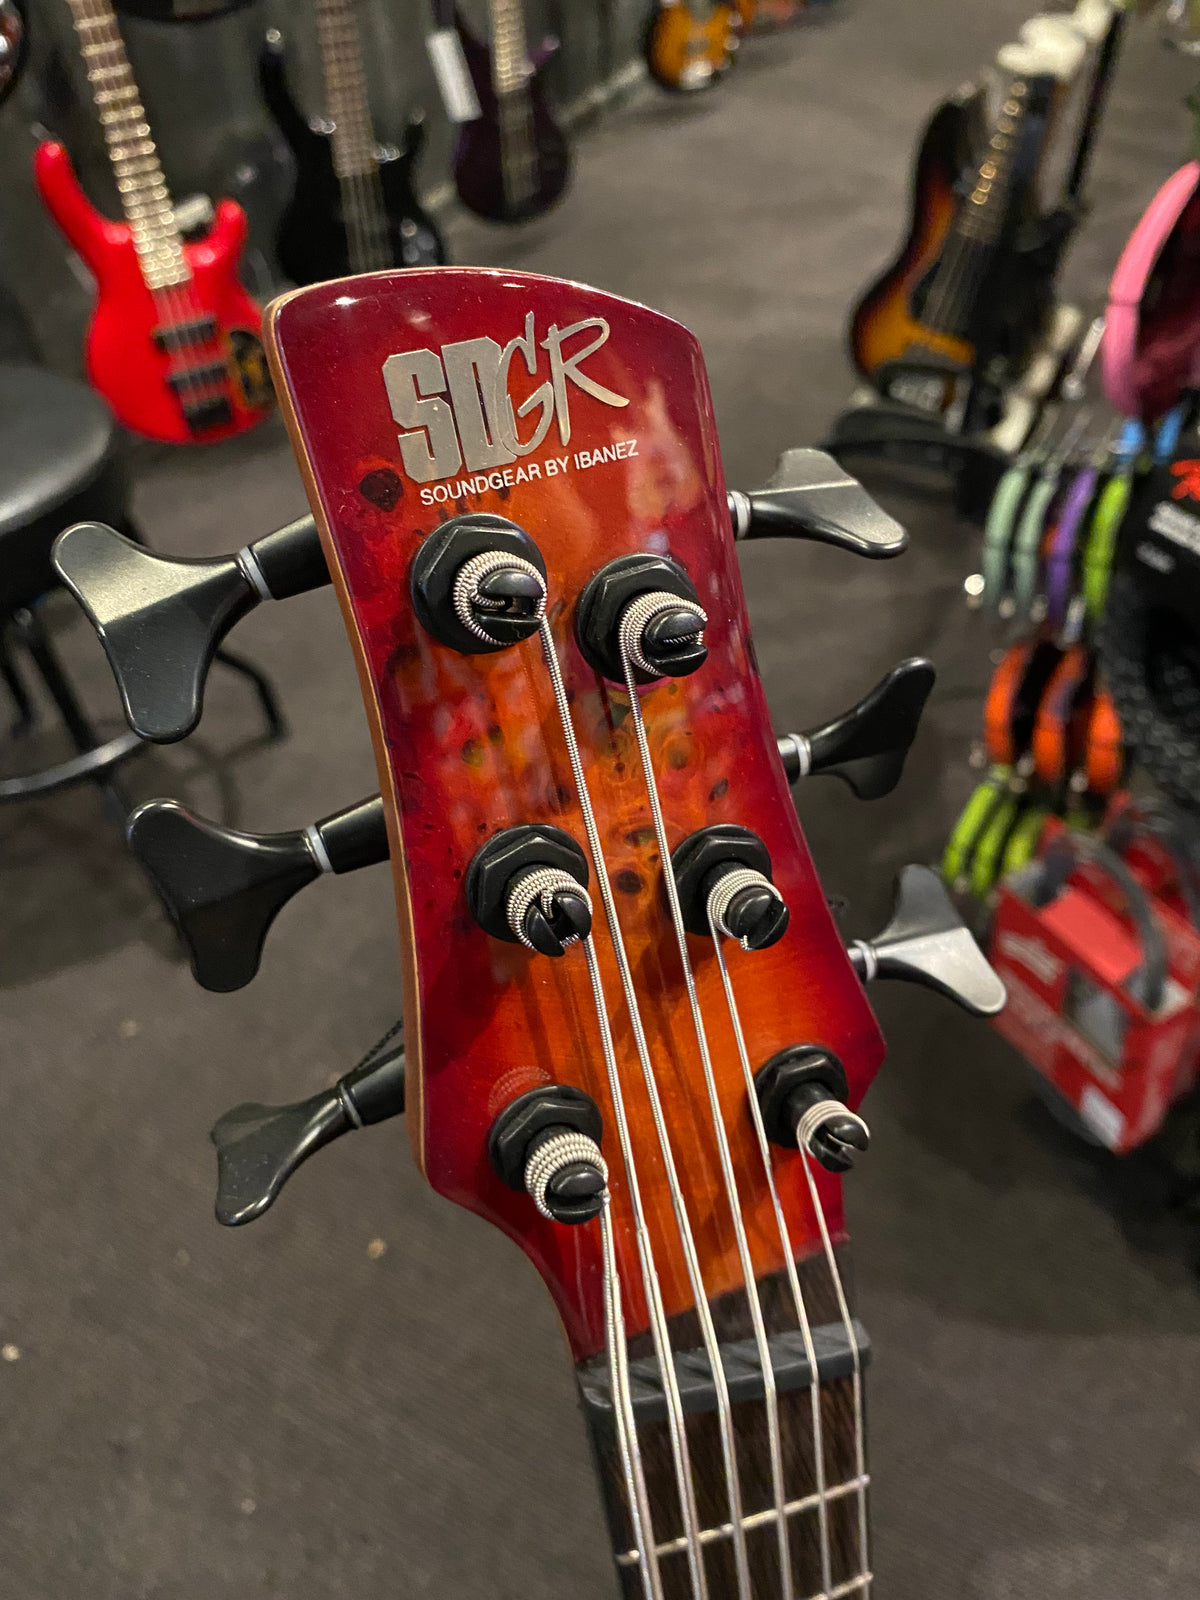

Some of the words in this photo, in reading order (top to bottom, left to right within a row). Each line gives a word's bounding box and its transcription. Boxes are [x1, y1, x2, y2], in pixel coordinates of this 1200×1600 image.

[382, 311, 630, 483] SDGR
[420, 463, 542, 505] SOUNDGEAR
[545, 456, 569, 477] BY
[575, 439, 639, 470] IBANEZ
